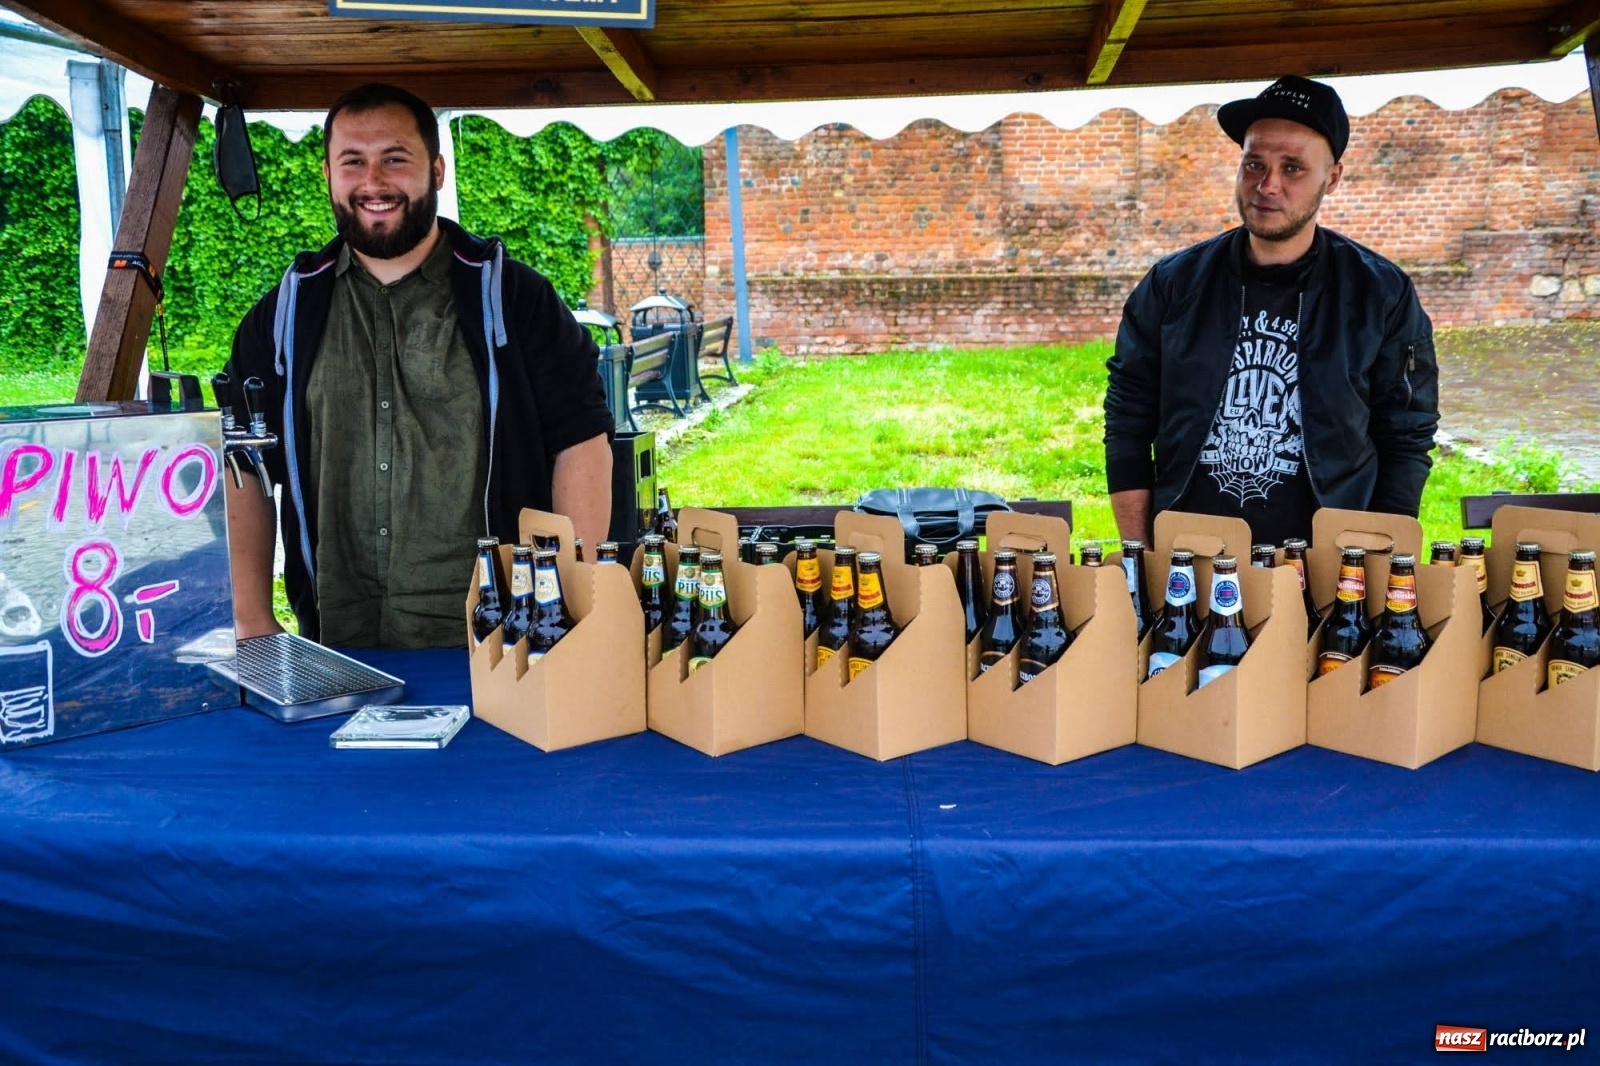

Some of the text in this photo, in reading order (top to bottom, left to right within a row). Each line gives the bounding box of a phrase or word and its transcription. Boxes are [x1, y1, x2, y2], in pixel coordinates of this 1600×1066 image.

[1223, 368, 1286, 426] LIVE
[0, 443, 218, 532] PIWO
[1223, 450, 1268, 474] SHOW
